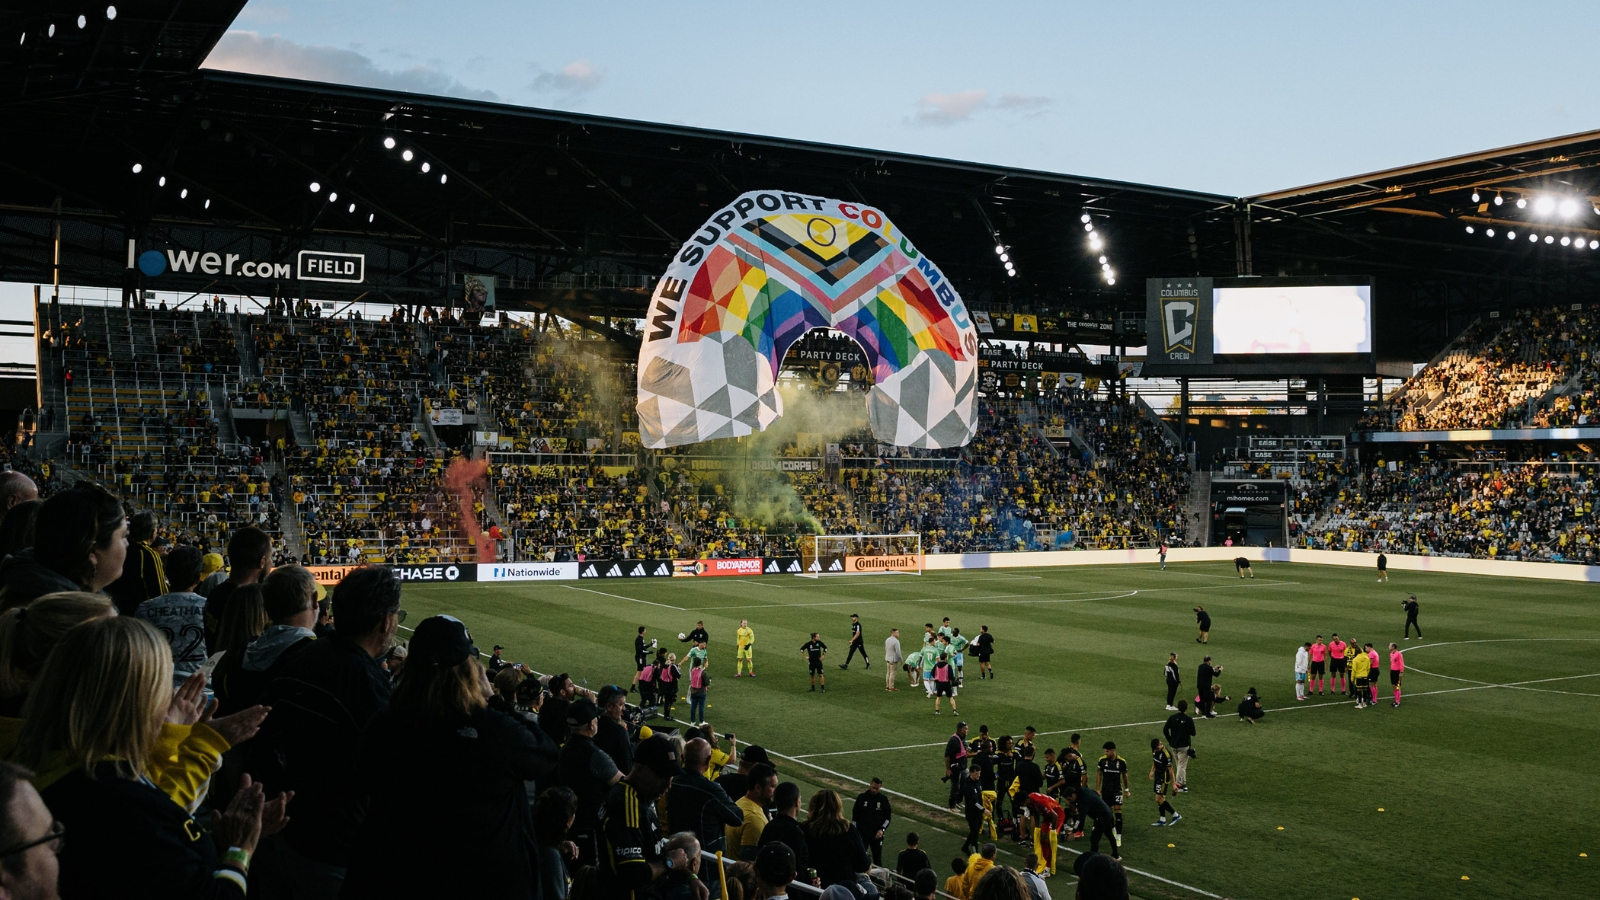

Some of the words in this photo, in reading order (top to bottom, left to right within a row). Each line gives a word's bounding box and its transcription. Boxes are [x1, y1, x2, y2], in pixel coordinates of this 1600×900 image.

[307, 258, 355, 275] FIELD
[648, 276, 688, 343] WE
[680, 193, 826, 267] SUPPORT
[838, 203, 977, 356] COLUMBUS
[1161, 289, 1199, 297] COLUMBUS
[1099, 323, 1114, 331] ZONE
[800, 350, 831, 360] PARTY
[835, 352, 860, 361] DECK
[983, 348, 1002, 356] EASE
[1169, 352, 1190, 360] CREW
[991, 360, 1019, 369] PARTY
[1021, 361, 1044, 370] DECK
[629, 434, 639, 443] 96
[781, 460, 812, 471] CORPS
[716, 560, 761, 570] BODYARMOR
[855, 556, 908, 571] Continental
[507, 567, 560, 577] Nationwide
[147, 604, 205, 618] CHEATHA
[615, 846, 642, 856] tipico
